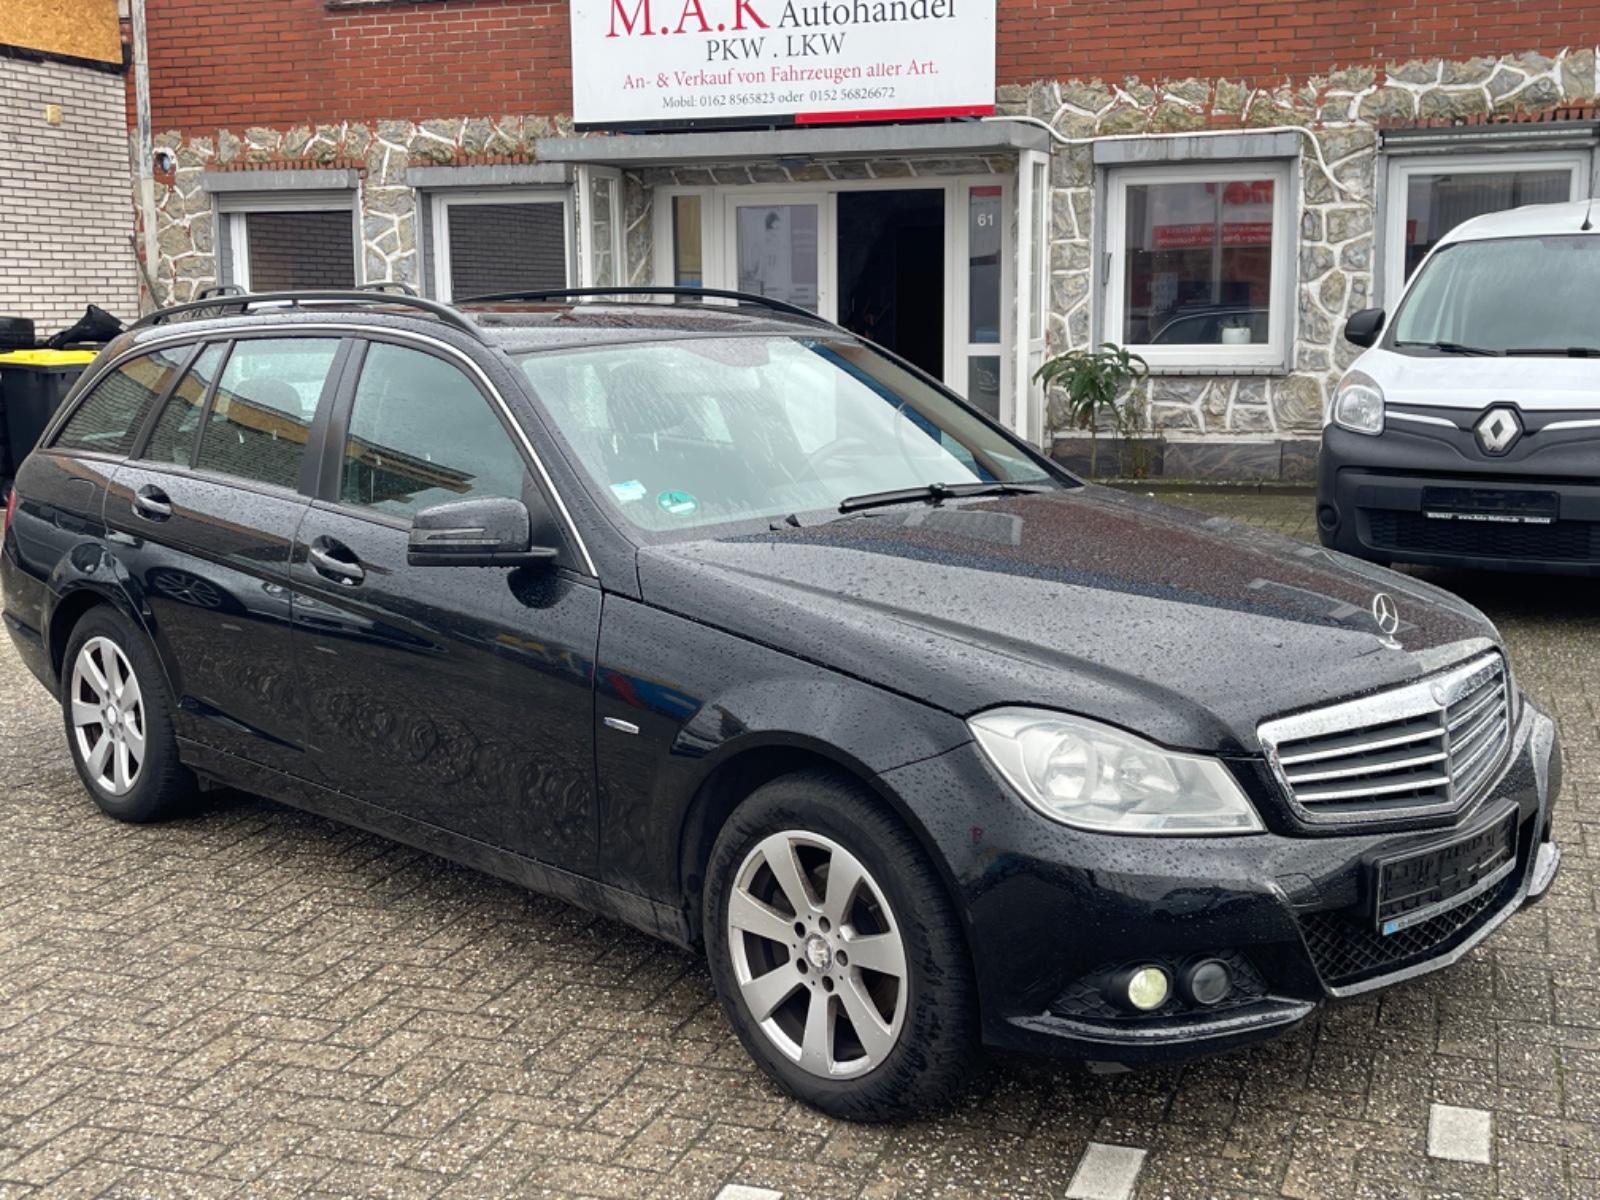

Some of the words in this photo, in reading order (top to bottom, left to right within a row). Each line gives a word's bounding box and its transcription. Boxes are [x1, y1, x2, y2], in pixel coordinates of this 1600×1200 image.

[606, 0, 771, 37] M.A.K
[778, 0, 956, 28] Autohandel
[706, 37, 764, 61] PKW
[786, 33, 846, 57] LKW
[623, 74, 651, 89] An-
[655, 71, 669, 88] &
[673, 68, 734, 87] Verkauf
[736, 71, 766, 83] von
[771, 64, 862, 84] Fahrzeugen
[866, 62, 902, 77] aller
[907, 59, 939, 75] Art.
[662, 96, 698, 109] Mobil:
[699, 93, 727, 107] 0162
[729, 91, 776, 106] 8565823
[778, 89, 804, 104] oder
[810, 89, 838, 103] 0152
[840, 87, 895, 101] 56826672
[977, 213, 994, 227] 61
